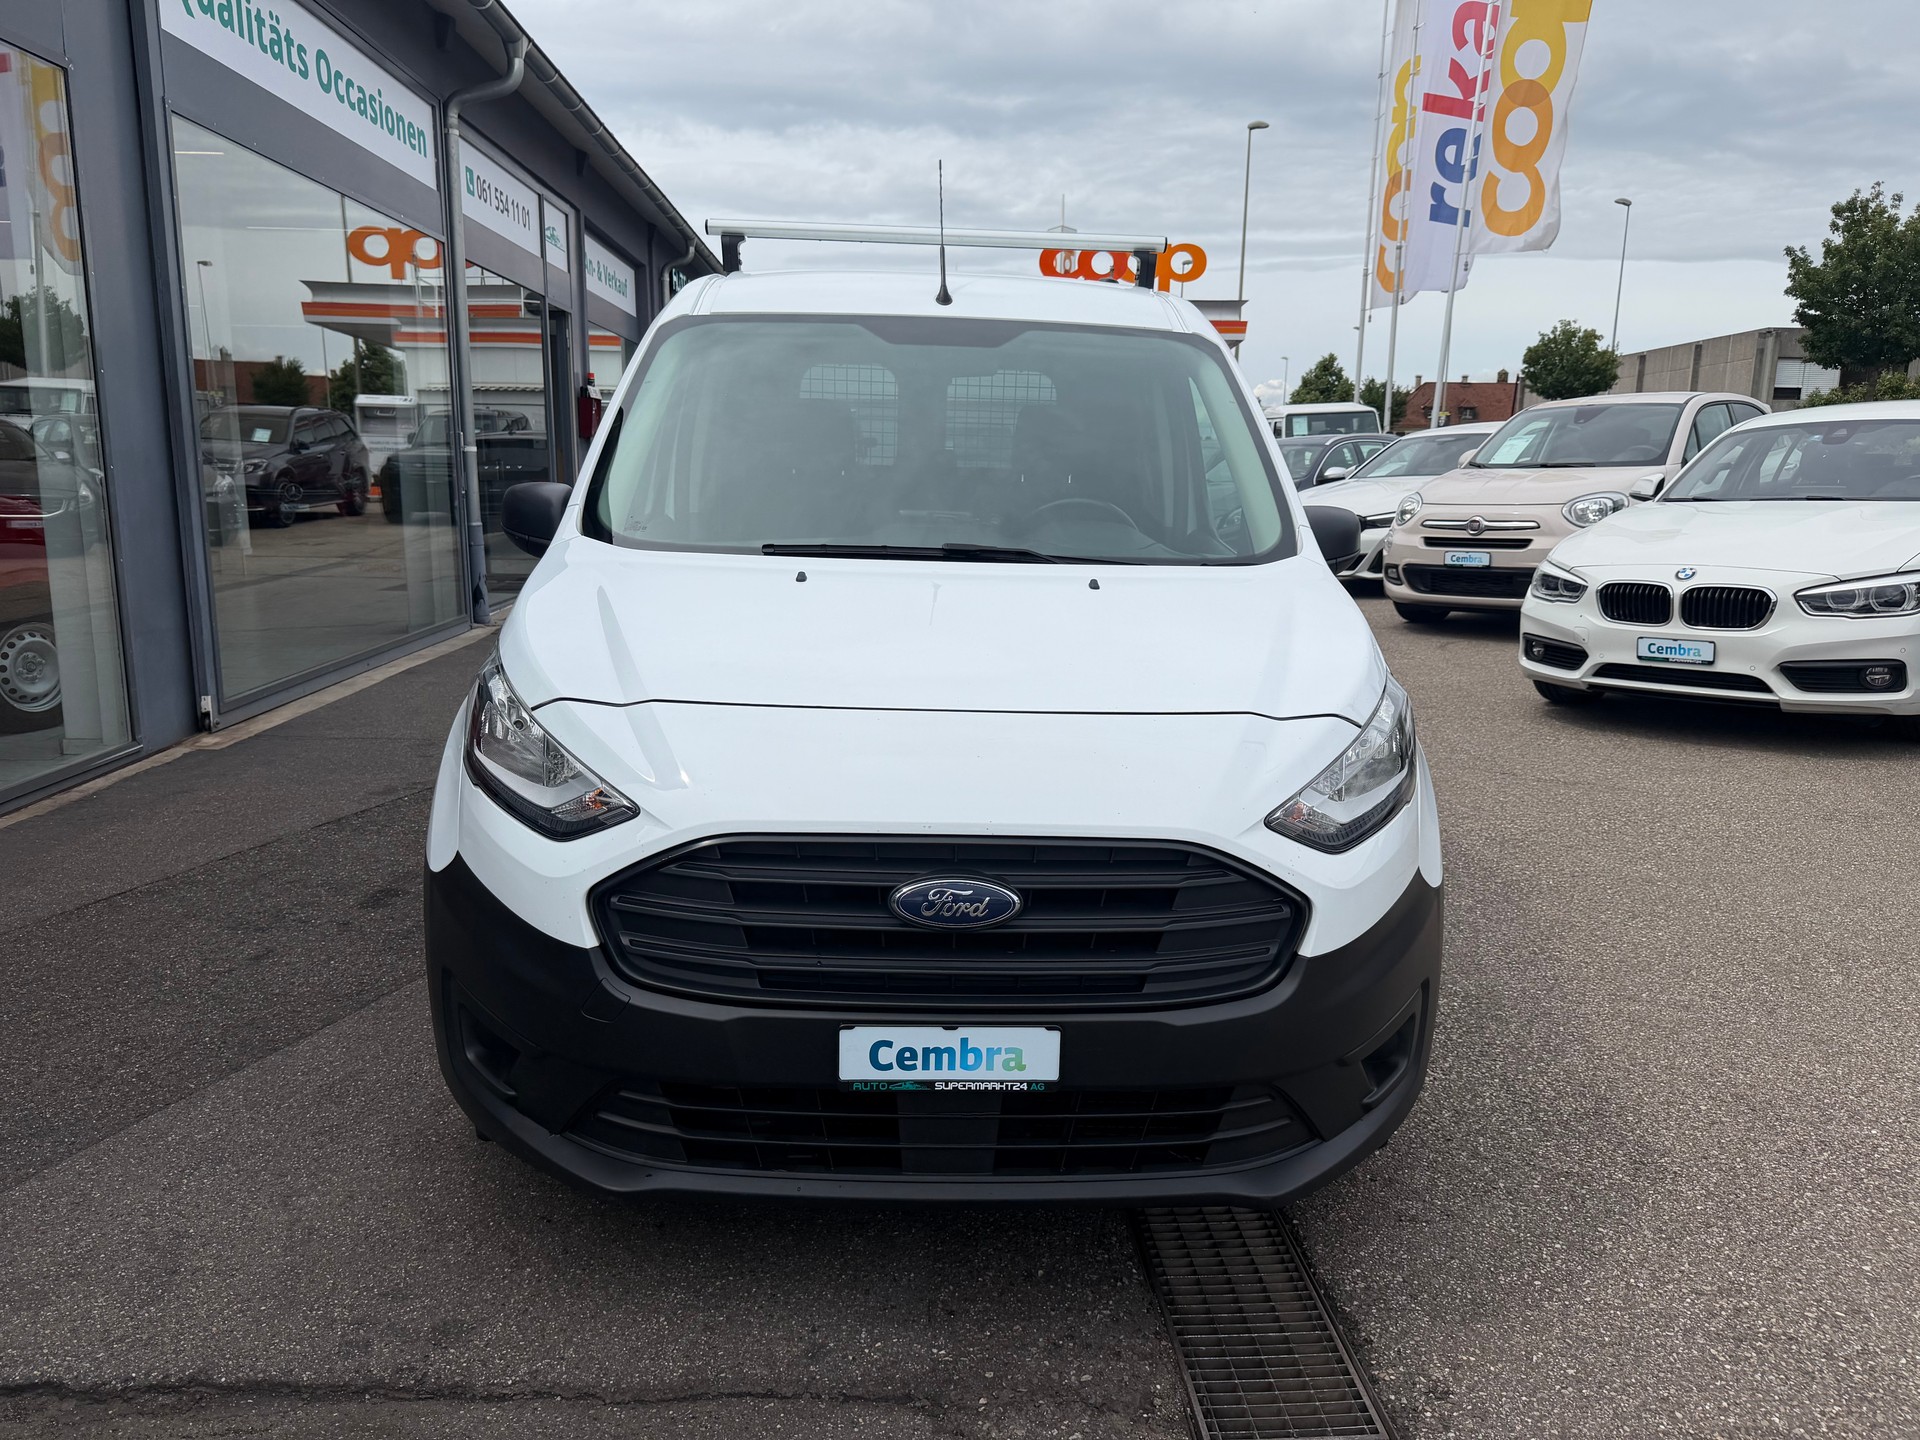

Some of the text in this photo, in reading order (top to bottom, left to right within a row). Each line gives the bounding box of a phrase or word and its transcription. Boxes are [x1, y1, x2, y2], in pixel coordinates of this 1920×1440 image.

[182, 0, 428, 158] ualitäts Occasionen
[1421, 0, 1501, 229] reka
[476, 173, 531, 232] 061 554 11 01
[596, 260, 603, 283] &
[603, 263, 628, 299] Verkauf
[1450, 554, 1484, 564] Cembra
[1647, 642, 1702, 658] Cembra
[920, 887, 991, 917] Ford
[868, 1036, 1027, 1072] Cembra
[852, 1081, 1046, 1091] AUTO SUPERMARKT24 AG
